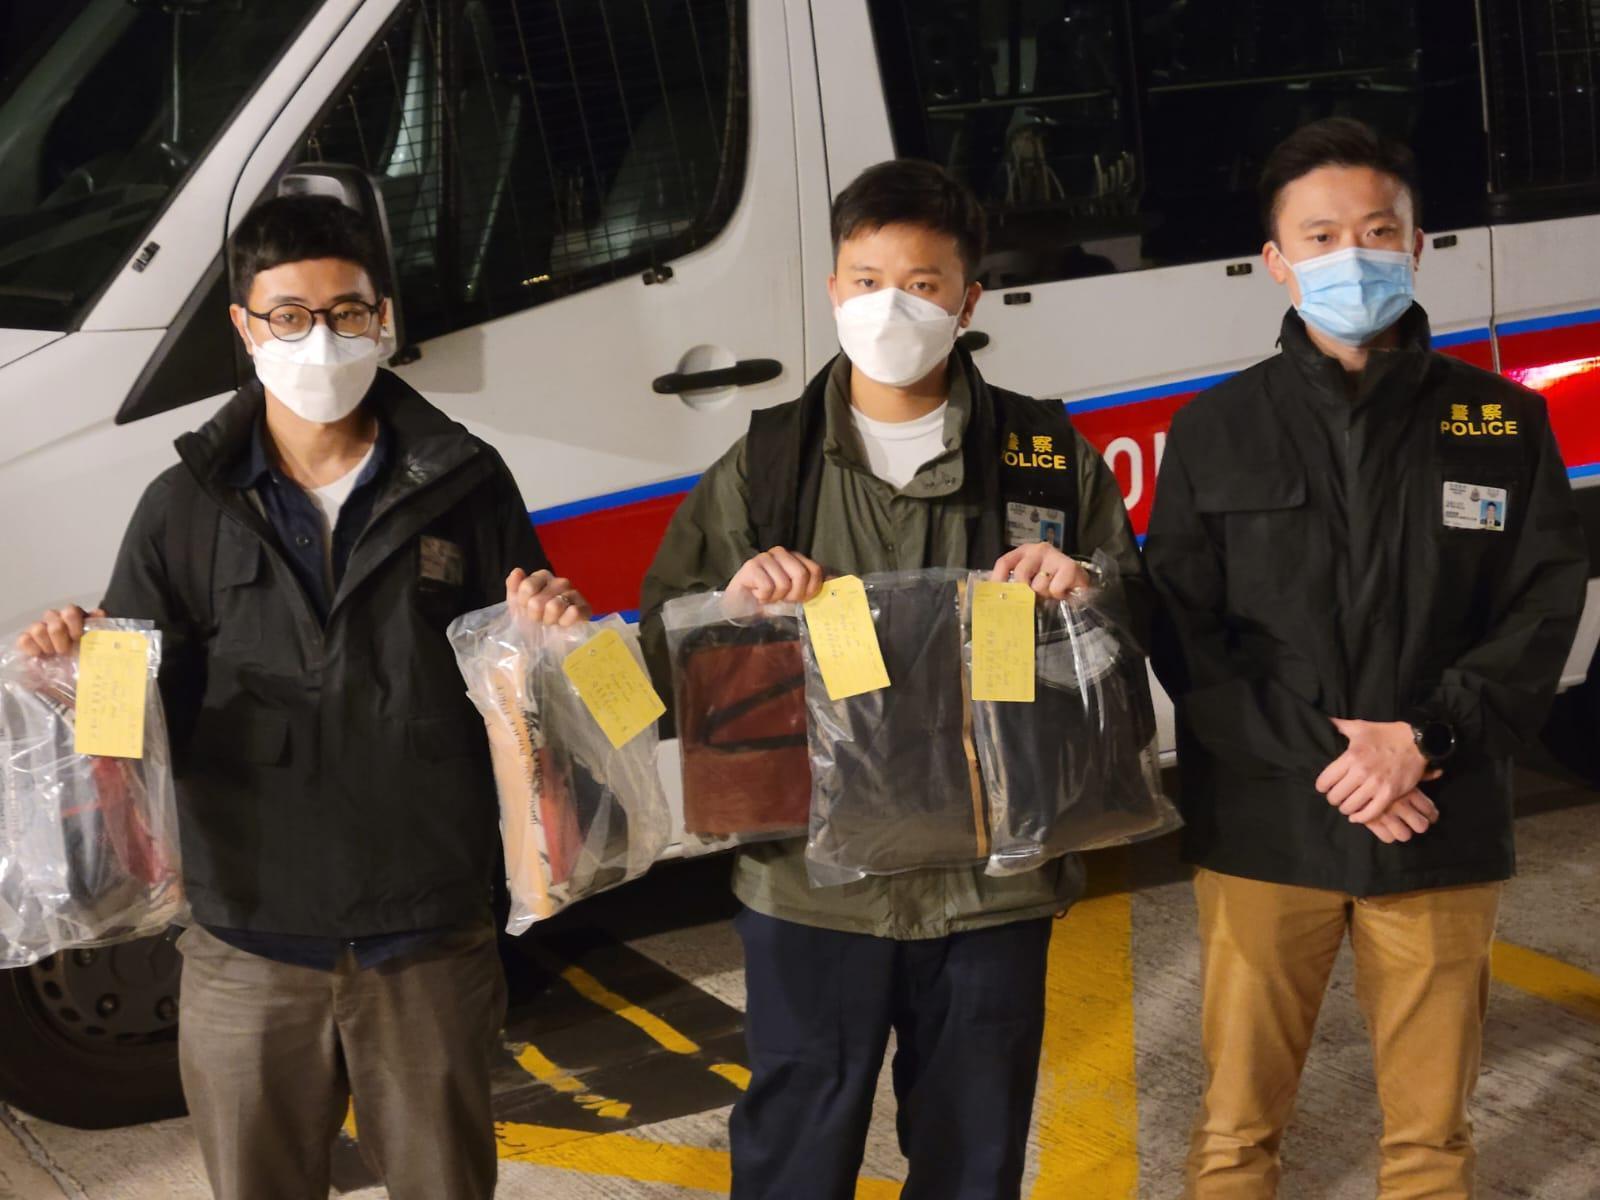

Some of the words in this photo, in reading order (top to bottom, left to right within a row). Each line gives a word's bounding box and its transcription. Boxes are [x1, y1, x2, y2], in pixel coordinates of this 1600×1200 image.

[1451, 403, 1502, 421] 警察
[1440, 420, 1519, 436] POLICE
[1002, 450, 1067, 470] OLICE
